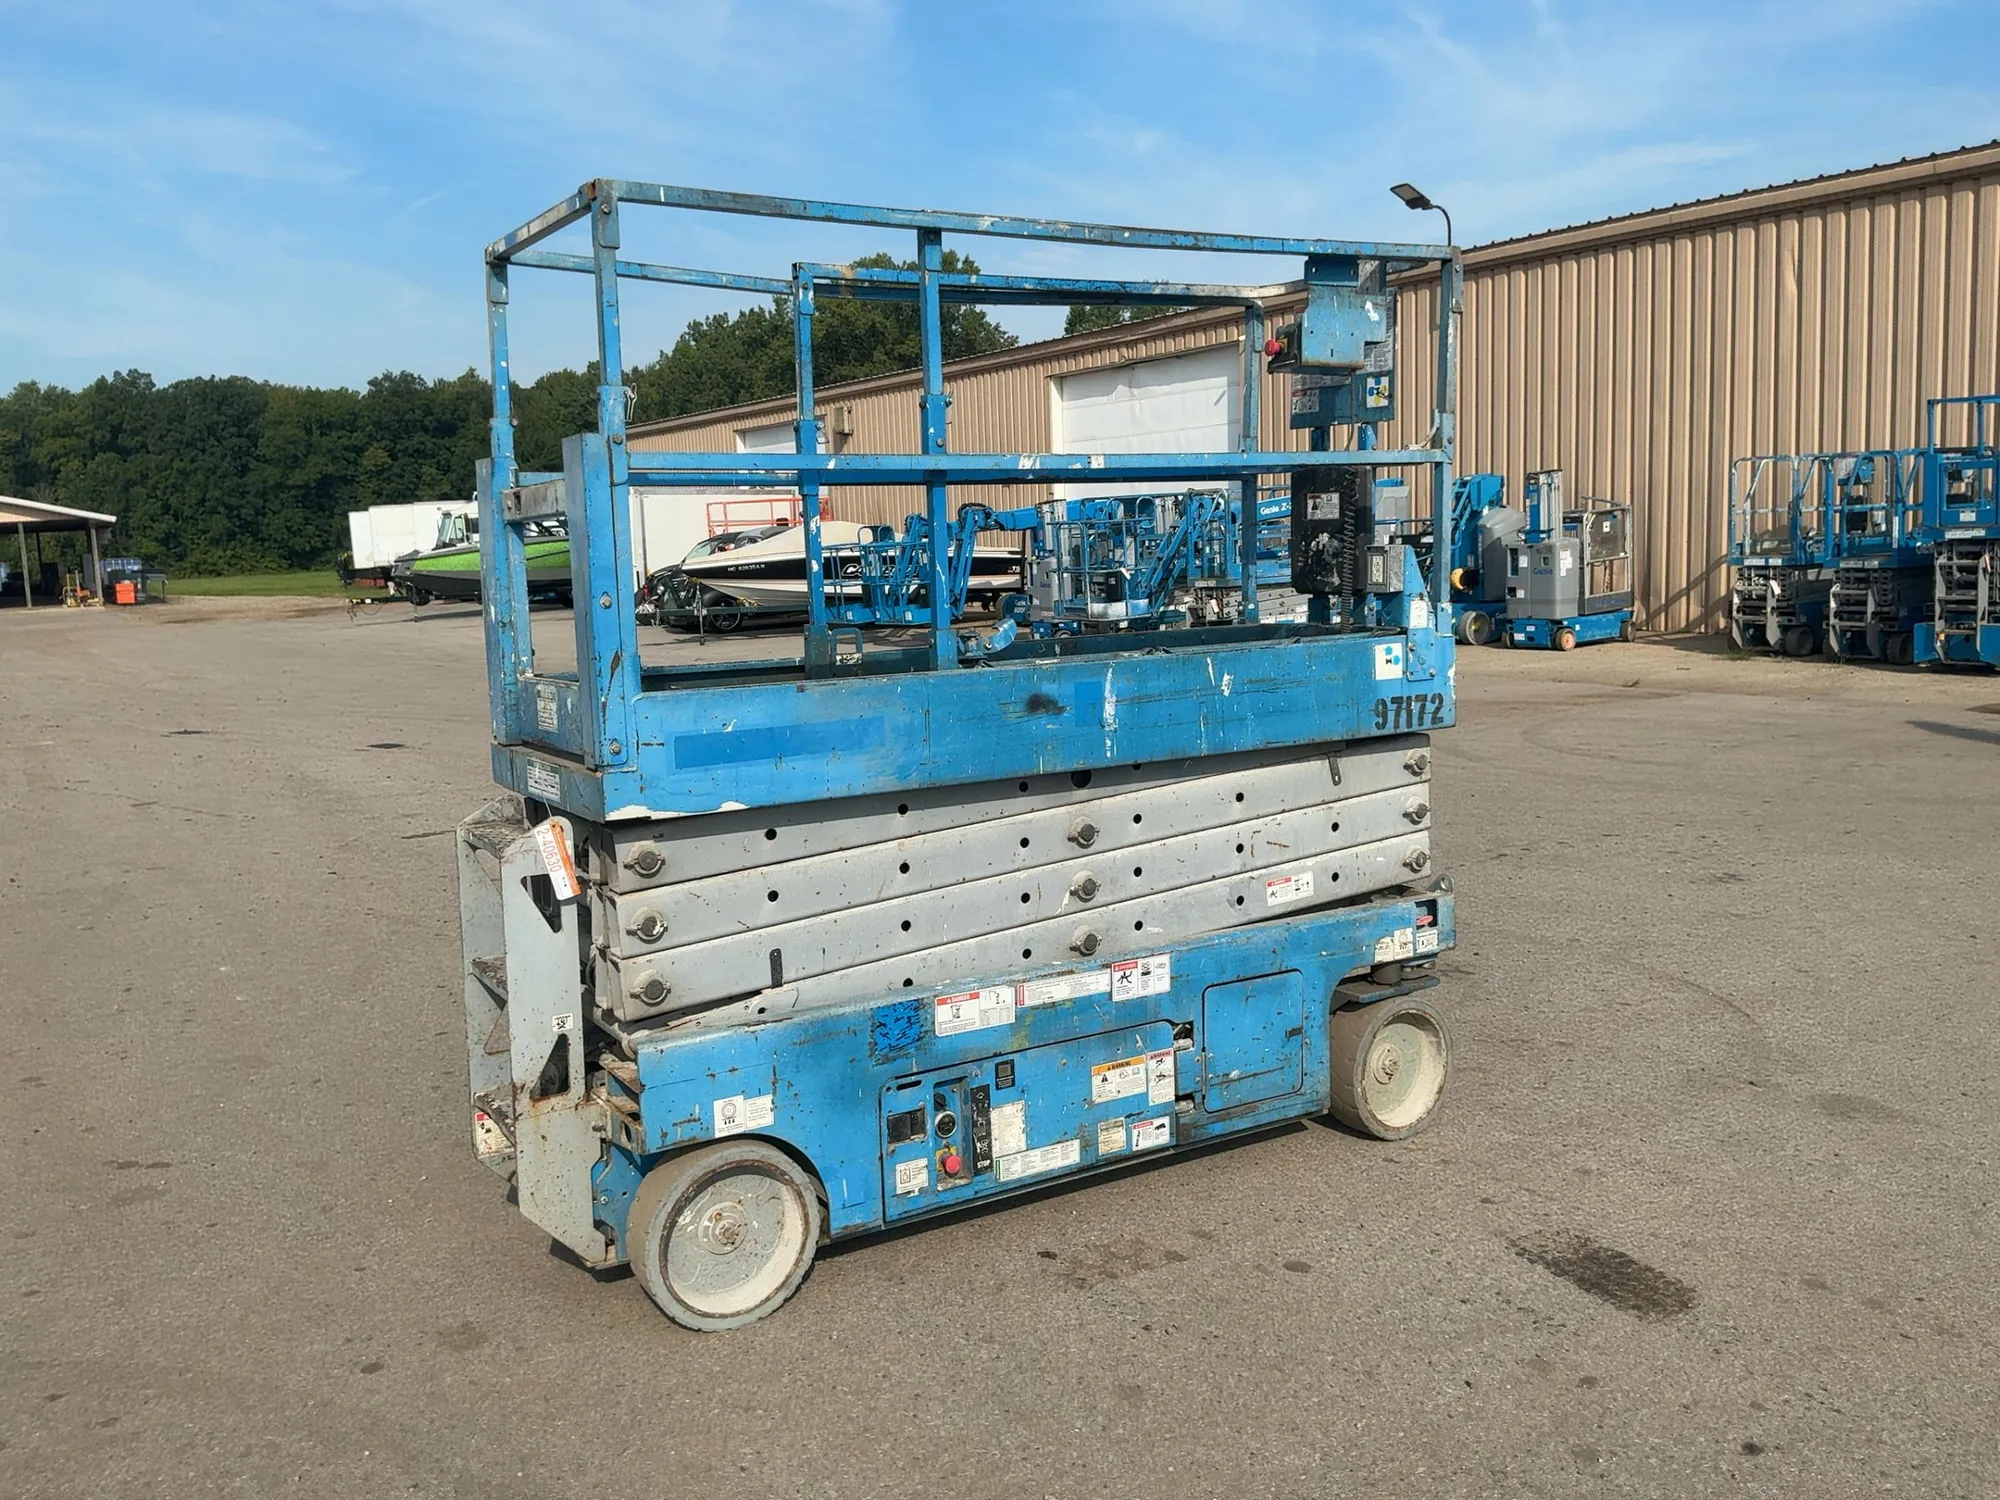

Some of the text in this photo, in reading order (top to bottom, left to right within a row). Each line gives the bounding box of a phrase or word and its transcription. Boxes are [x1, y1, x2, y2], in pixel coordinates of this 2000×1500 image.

[1260, 506, 1279, 515] Genie
[1374, 692, 1444, 730] 97172
[536, 828, 562, 873] 2-40630
[977, 1159, 991, 1168] STOP
